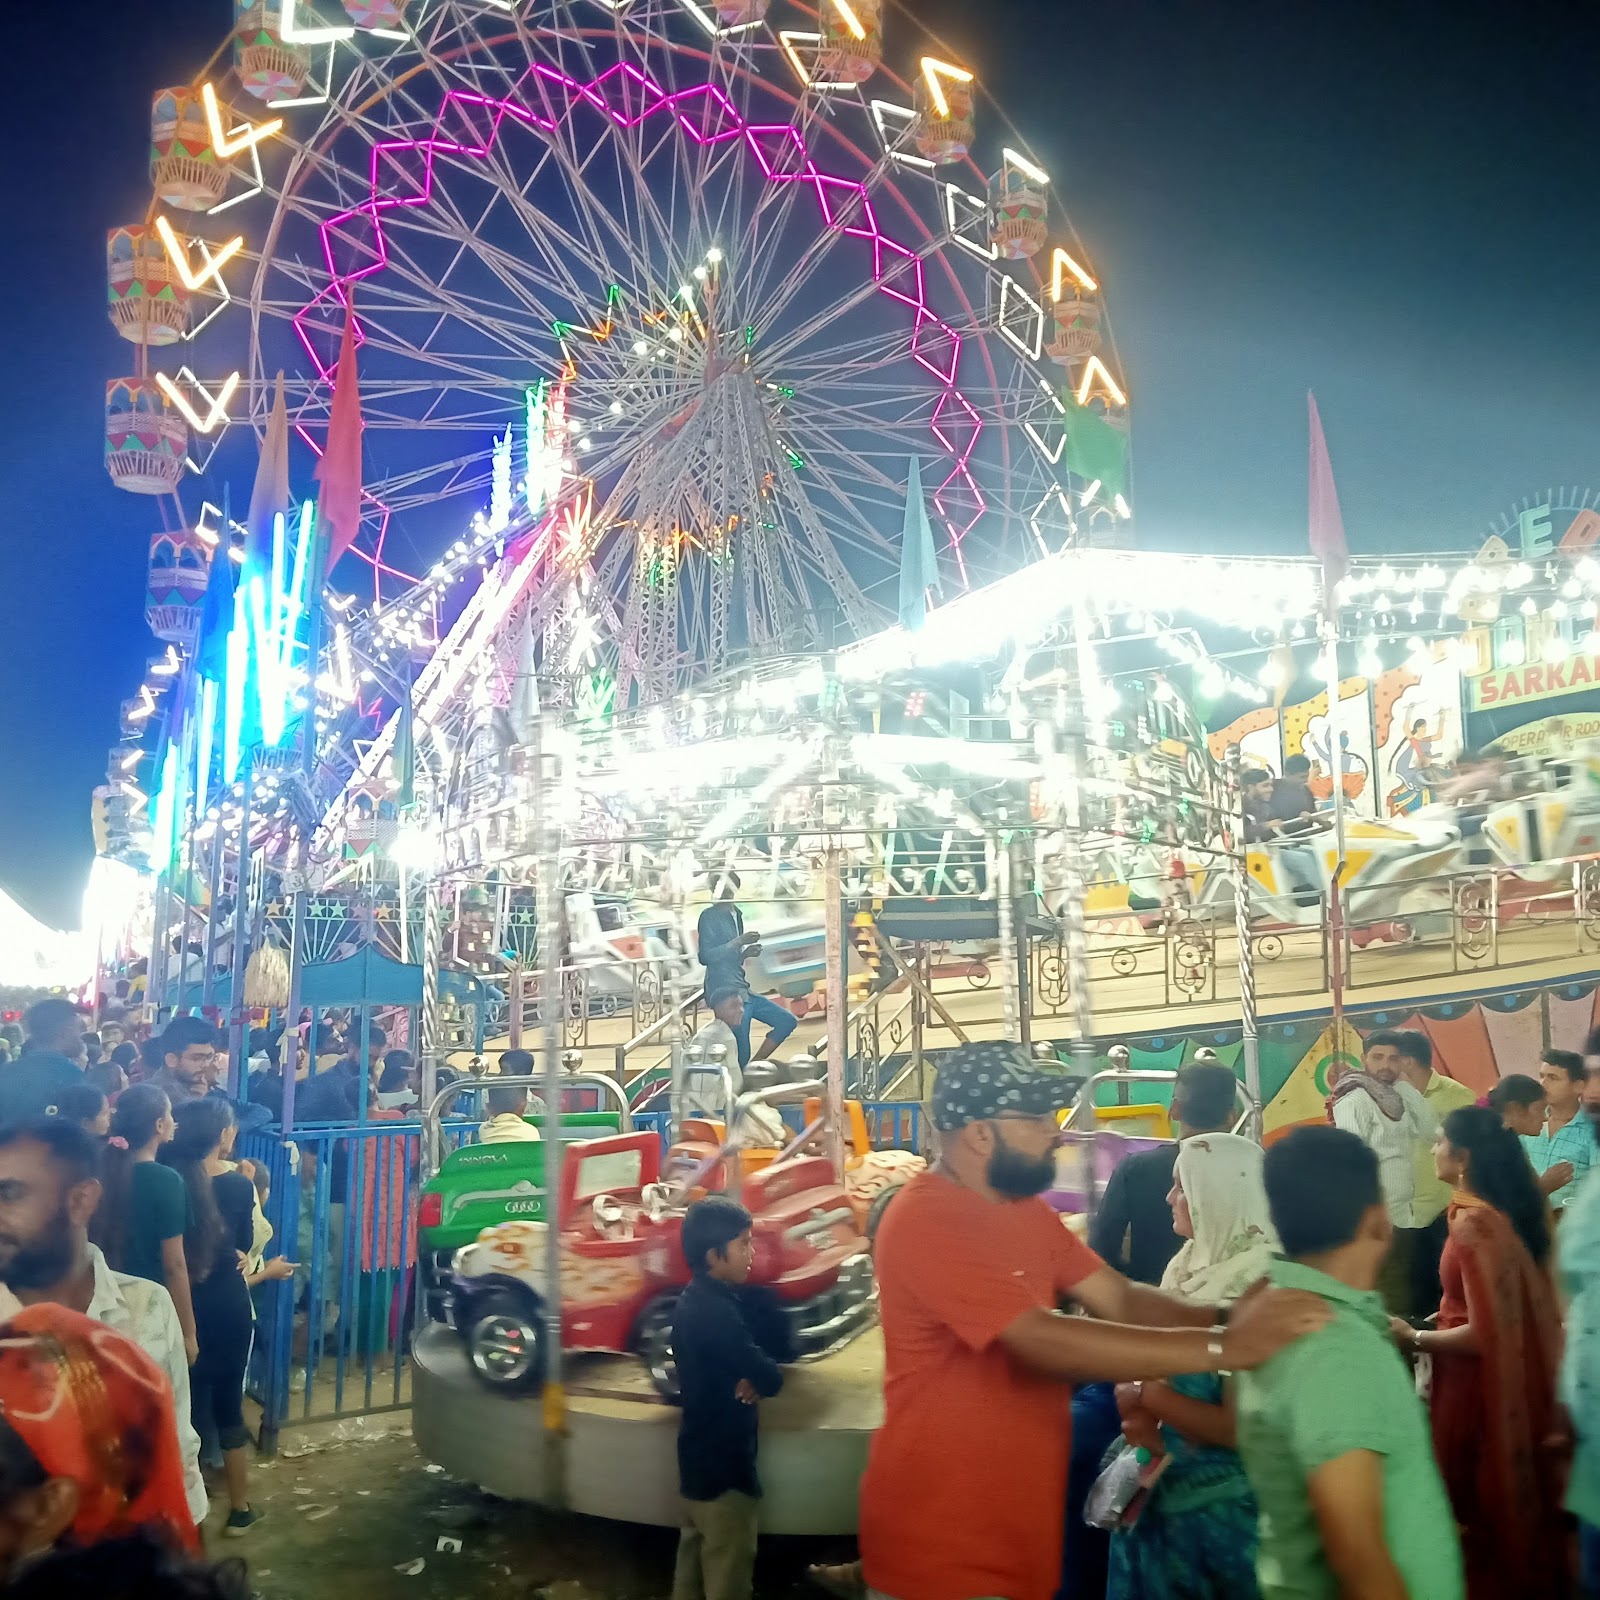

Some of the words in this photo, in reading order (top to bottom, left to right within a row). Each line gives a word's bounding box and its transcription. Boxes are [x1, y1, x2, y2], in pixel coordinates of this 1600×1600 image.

[1460, 599, 1600, 678] DANC
[1501, 724, 1572, 749] OPERAR
[1575, 720, 1600, 737] ROO
